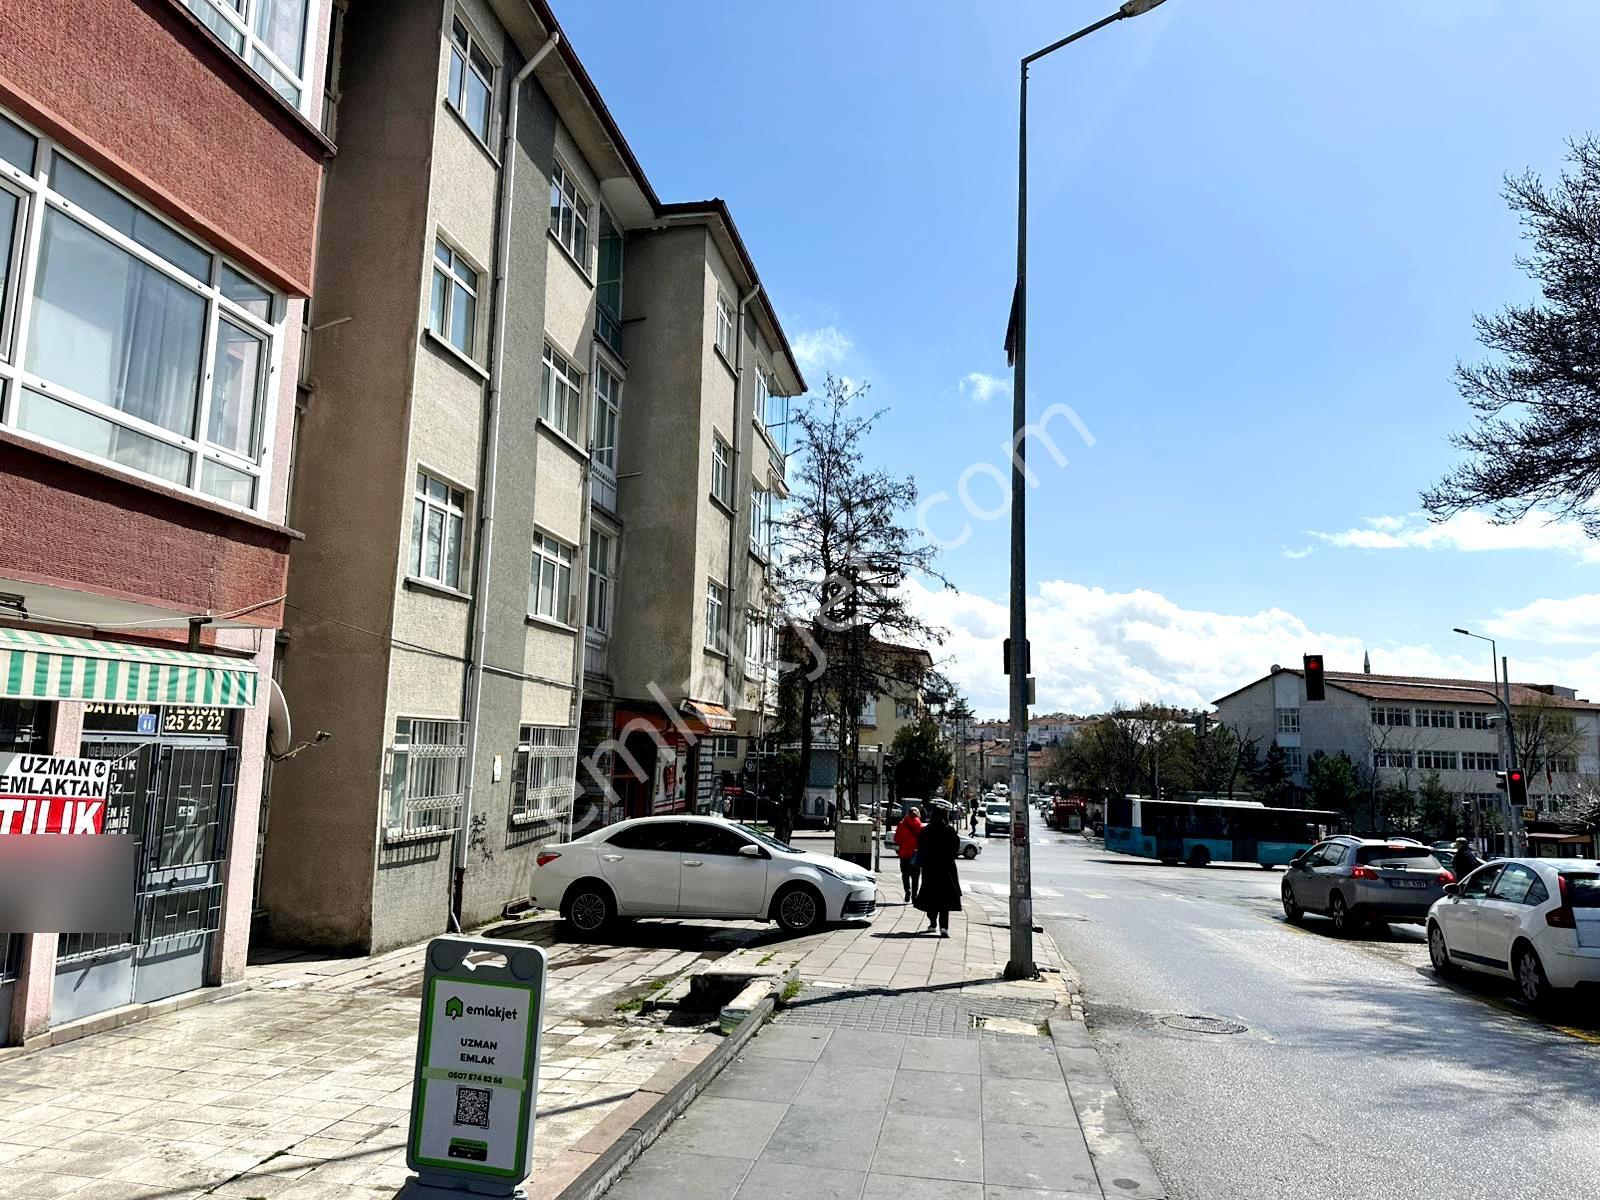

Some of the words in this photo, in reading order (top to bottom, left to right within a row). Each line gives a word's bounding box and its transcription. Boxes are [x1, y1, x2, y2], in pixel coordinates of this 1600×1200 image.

[165, 715, 185, 731] 325
[187, 715, 204, 731] 25
[206, 716, 222, 731] 22
[20, 756, 91, 777] UZMAN
[0, 775, 104, 797] EMLAKTAN
[466, 1005, 517, 1021] emlakjet
[460, 1037, 497, 1050] UZMAN
[459, 1053, 495, 1065] EMLAK
